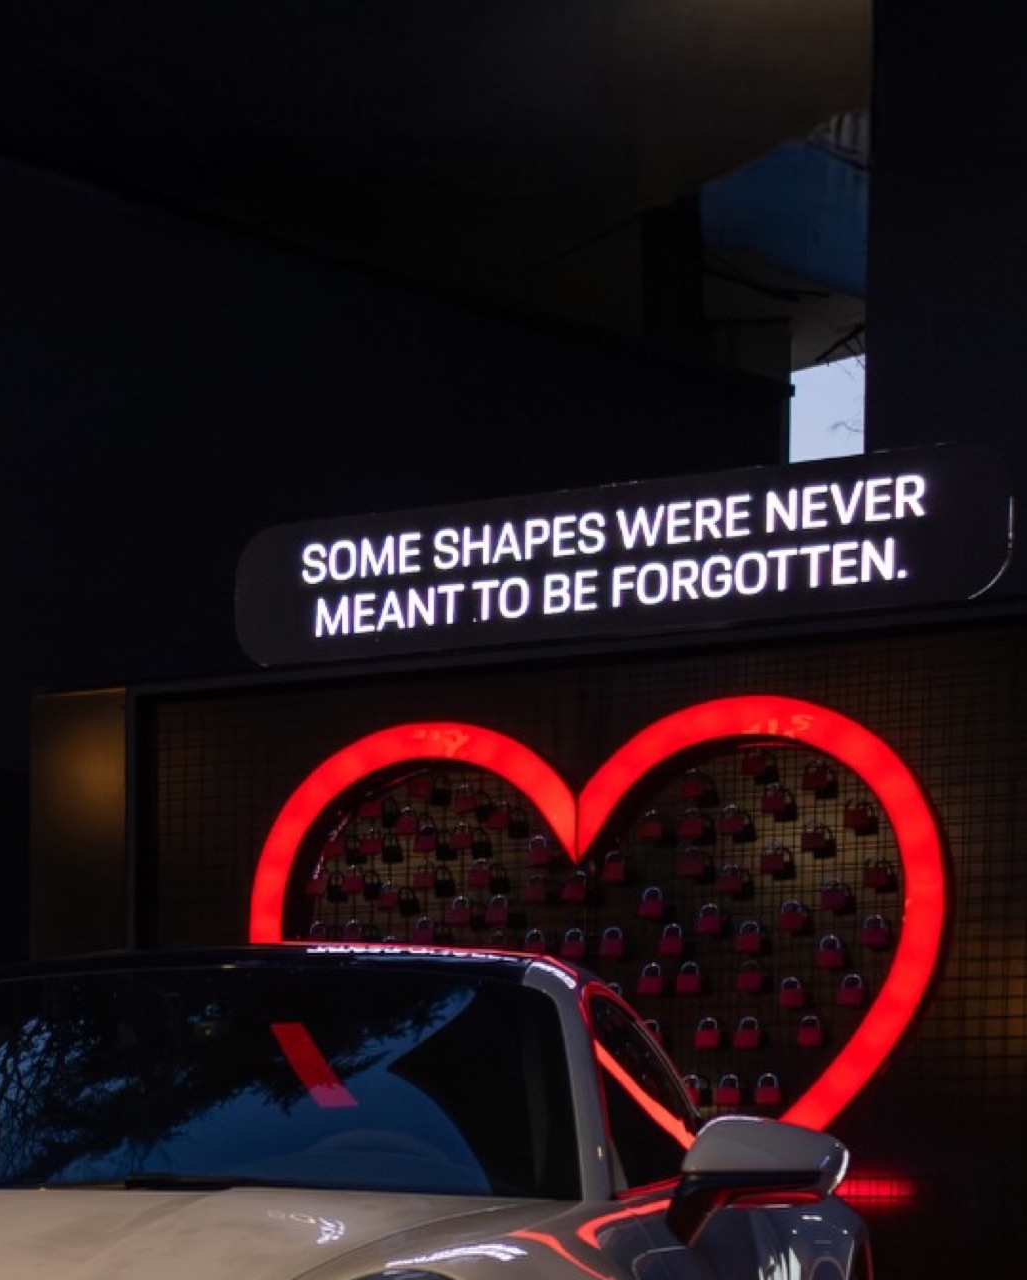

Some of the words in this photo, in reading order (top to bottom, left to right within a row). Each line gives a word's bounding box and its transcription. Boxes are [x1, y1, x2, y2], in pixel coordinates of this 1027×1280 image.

[301, 531, 422, 585] SOME
[433, 511, 606, 570] SHAPES
[615, 493, 752, 551] WERE
[765, 473, 927, 534] NEVER
[314, 583, 466, 638] MEANT
[471, 575, 531, 621] TO
[543, 568, 599, 615] BE
[611, 536, 910, 608] FORGOTTEN.
